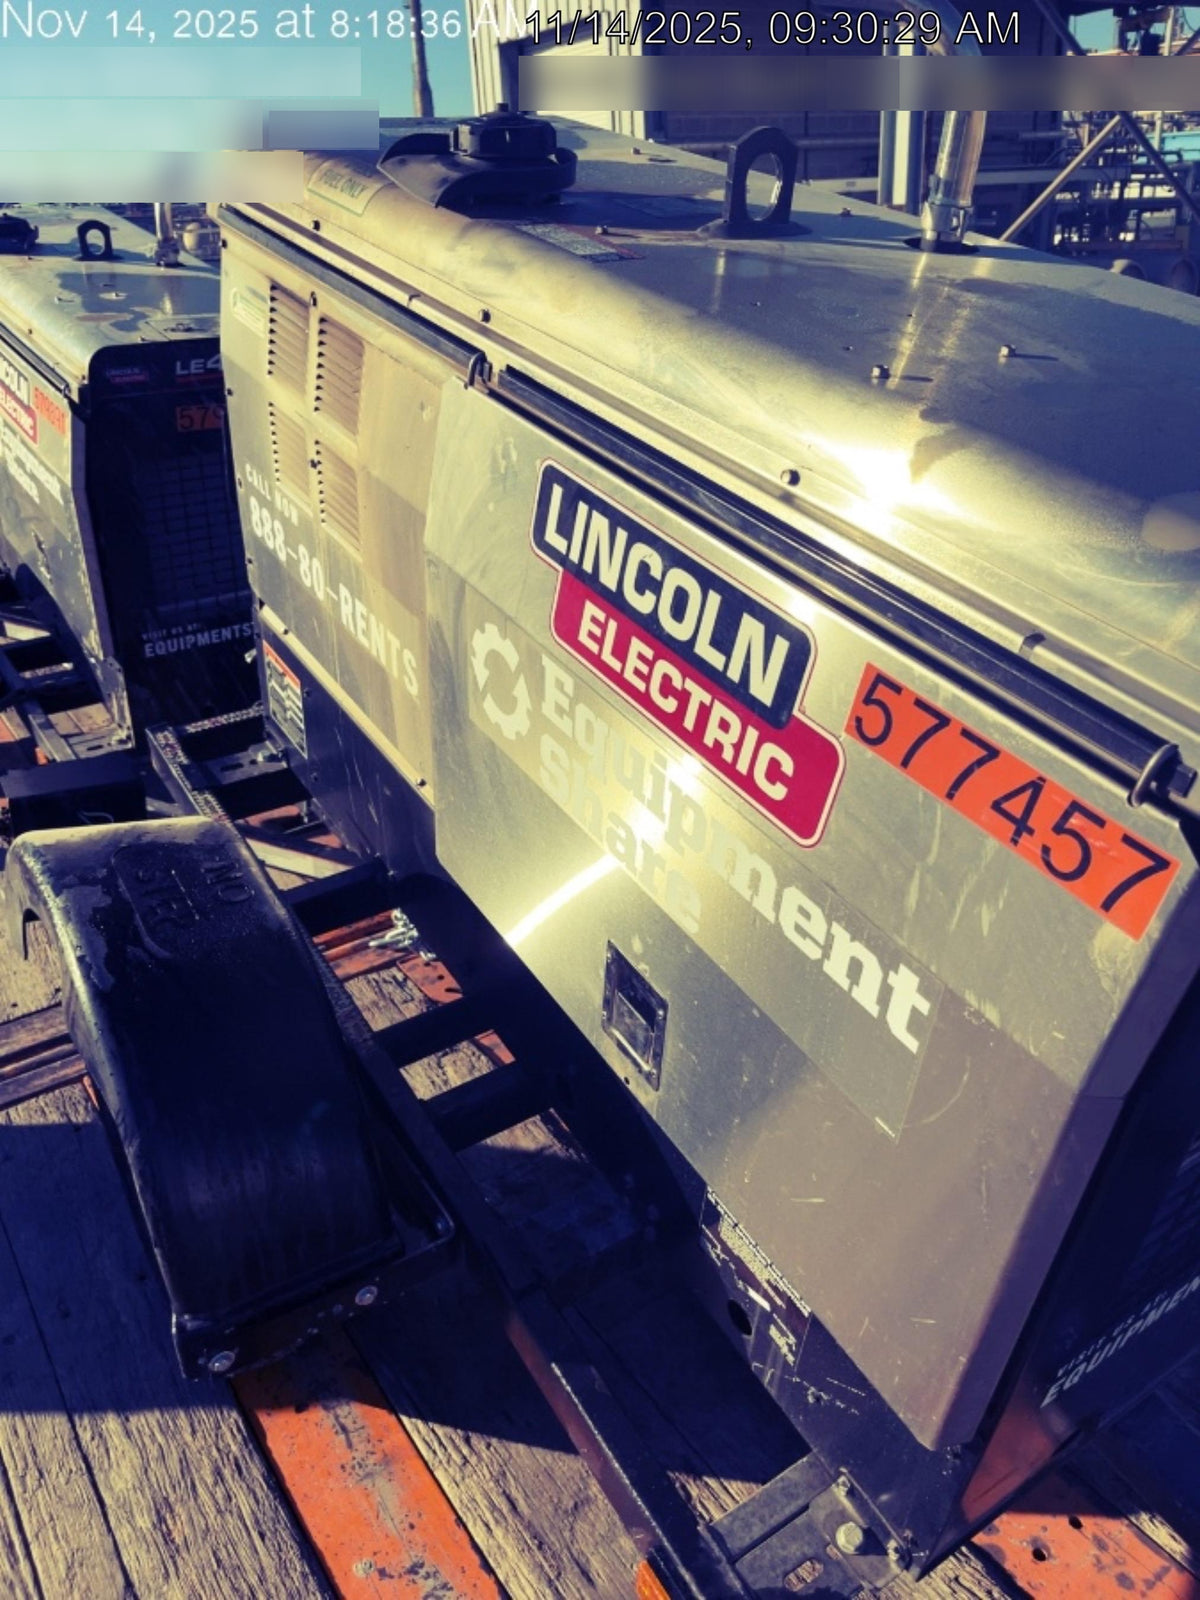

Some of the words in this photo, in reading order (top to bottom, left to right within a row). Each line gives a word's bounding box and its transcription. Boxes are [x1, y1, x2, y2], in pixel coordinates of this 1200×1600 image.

[245, 463, 271, 501] CALL
[250, 496, 419, 697] 888-80-RENTS
[543, 484, 789, 707] LINCOLN
[578, 607, 794, 801] ELECTRIC
[855, 672, 1171, 913] 577457
[539, 734, 699, 933] Share
[541, 653, 931, 1055] Equipment
